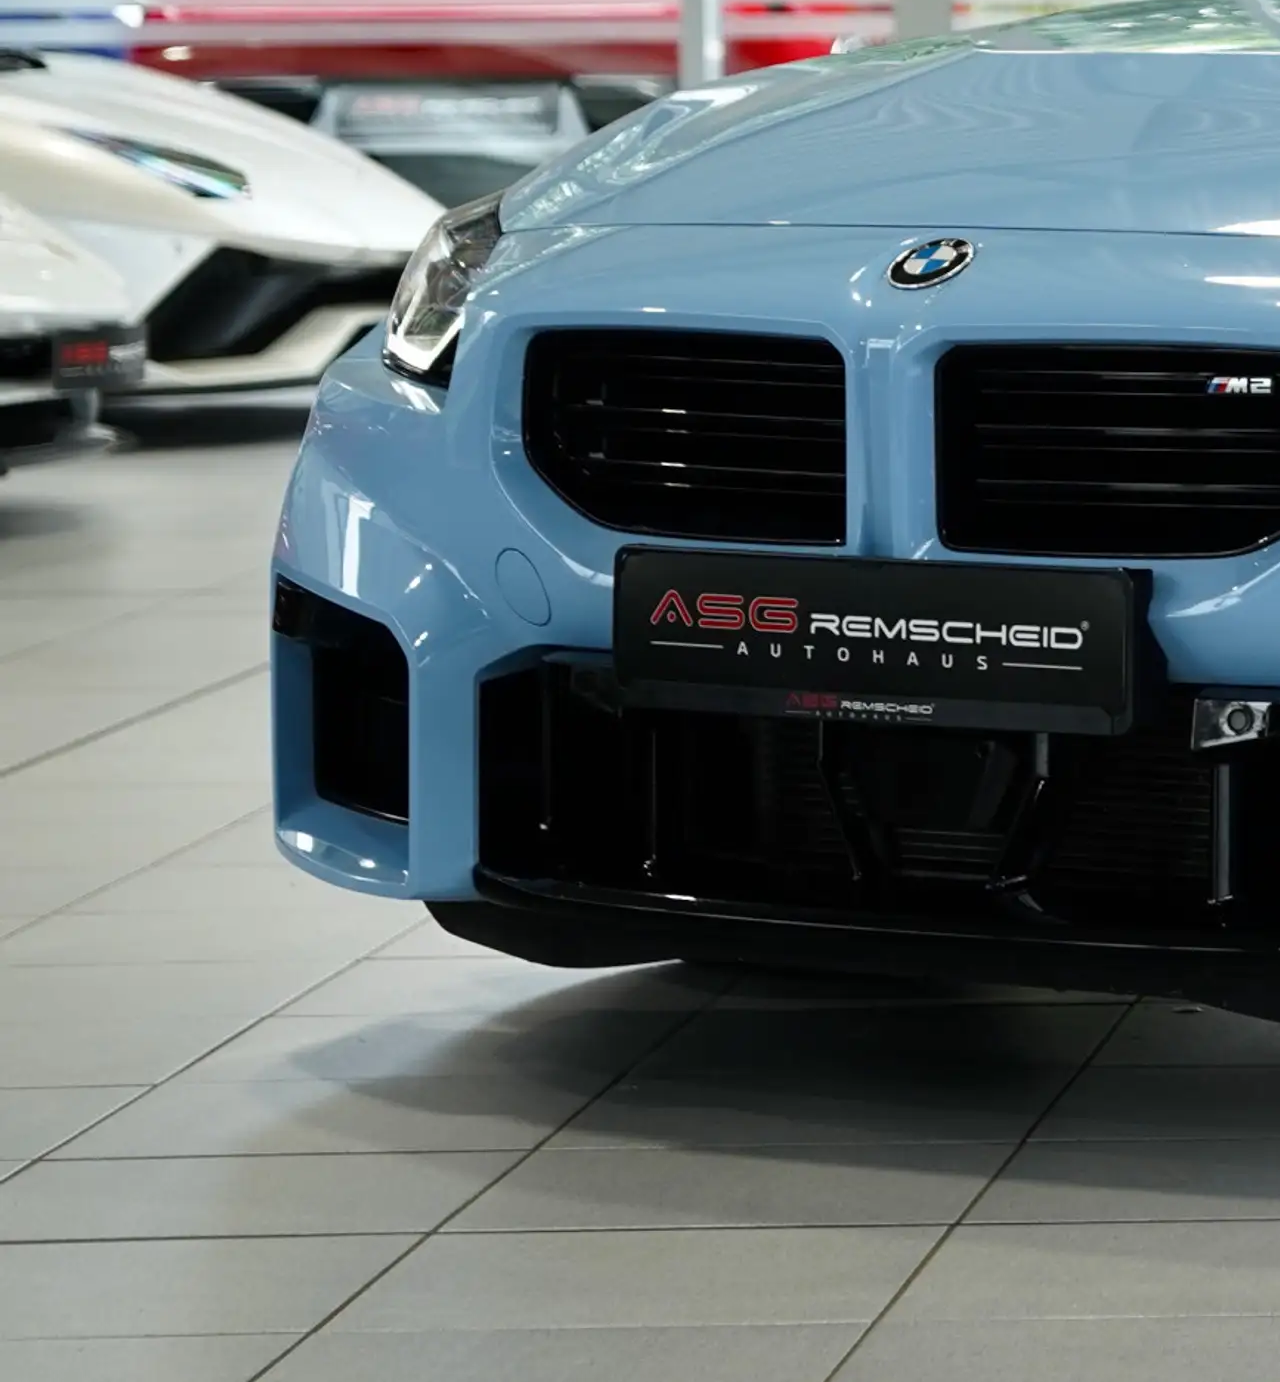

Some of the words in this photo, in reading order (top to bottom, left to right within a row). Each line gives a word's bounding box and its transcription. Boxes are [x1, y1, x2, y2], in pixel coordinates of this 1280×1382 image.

[1222, 377, 1272, 394] M2
[650, 589, 799, 634] ASG
[736, 640, 989, 671] AUTOHAUS
